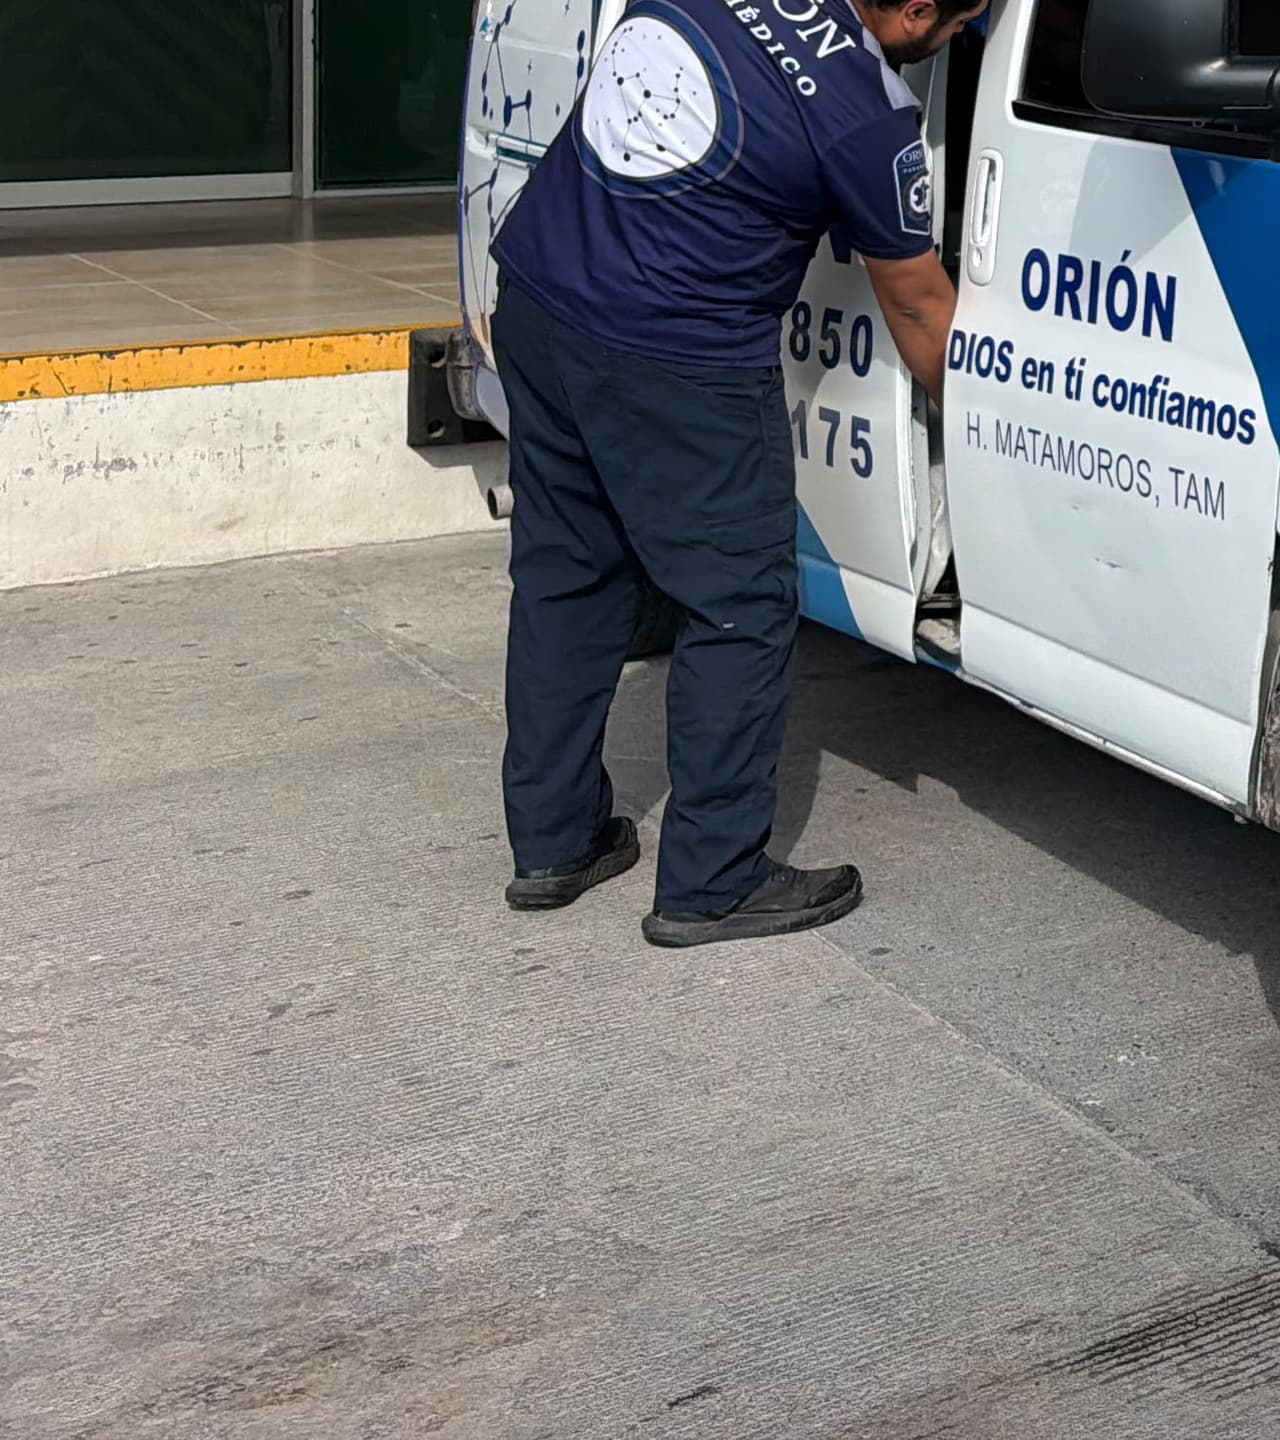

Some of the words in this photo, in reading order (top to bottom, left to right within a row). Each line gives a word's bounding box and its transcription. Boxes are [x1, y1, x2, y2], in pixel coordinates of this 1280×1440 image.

[1021, 248, 1177, 342] ORIÓN
[948, 329, 1014, 383] DIOS
[1021, 356, 1054, 394] en
[1064, 357, 1086, 401] ti
[1092, 373, 1256, 445] confiamos
[966, 410, 989, 451] H.
[995, 420, 1161, 508] MATAMOROS,
[1168, 466, 1226, 521] TAM
